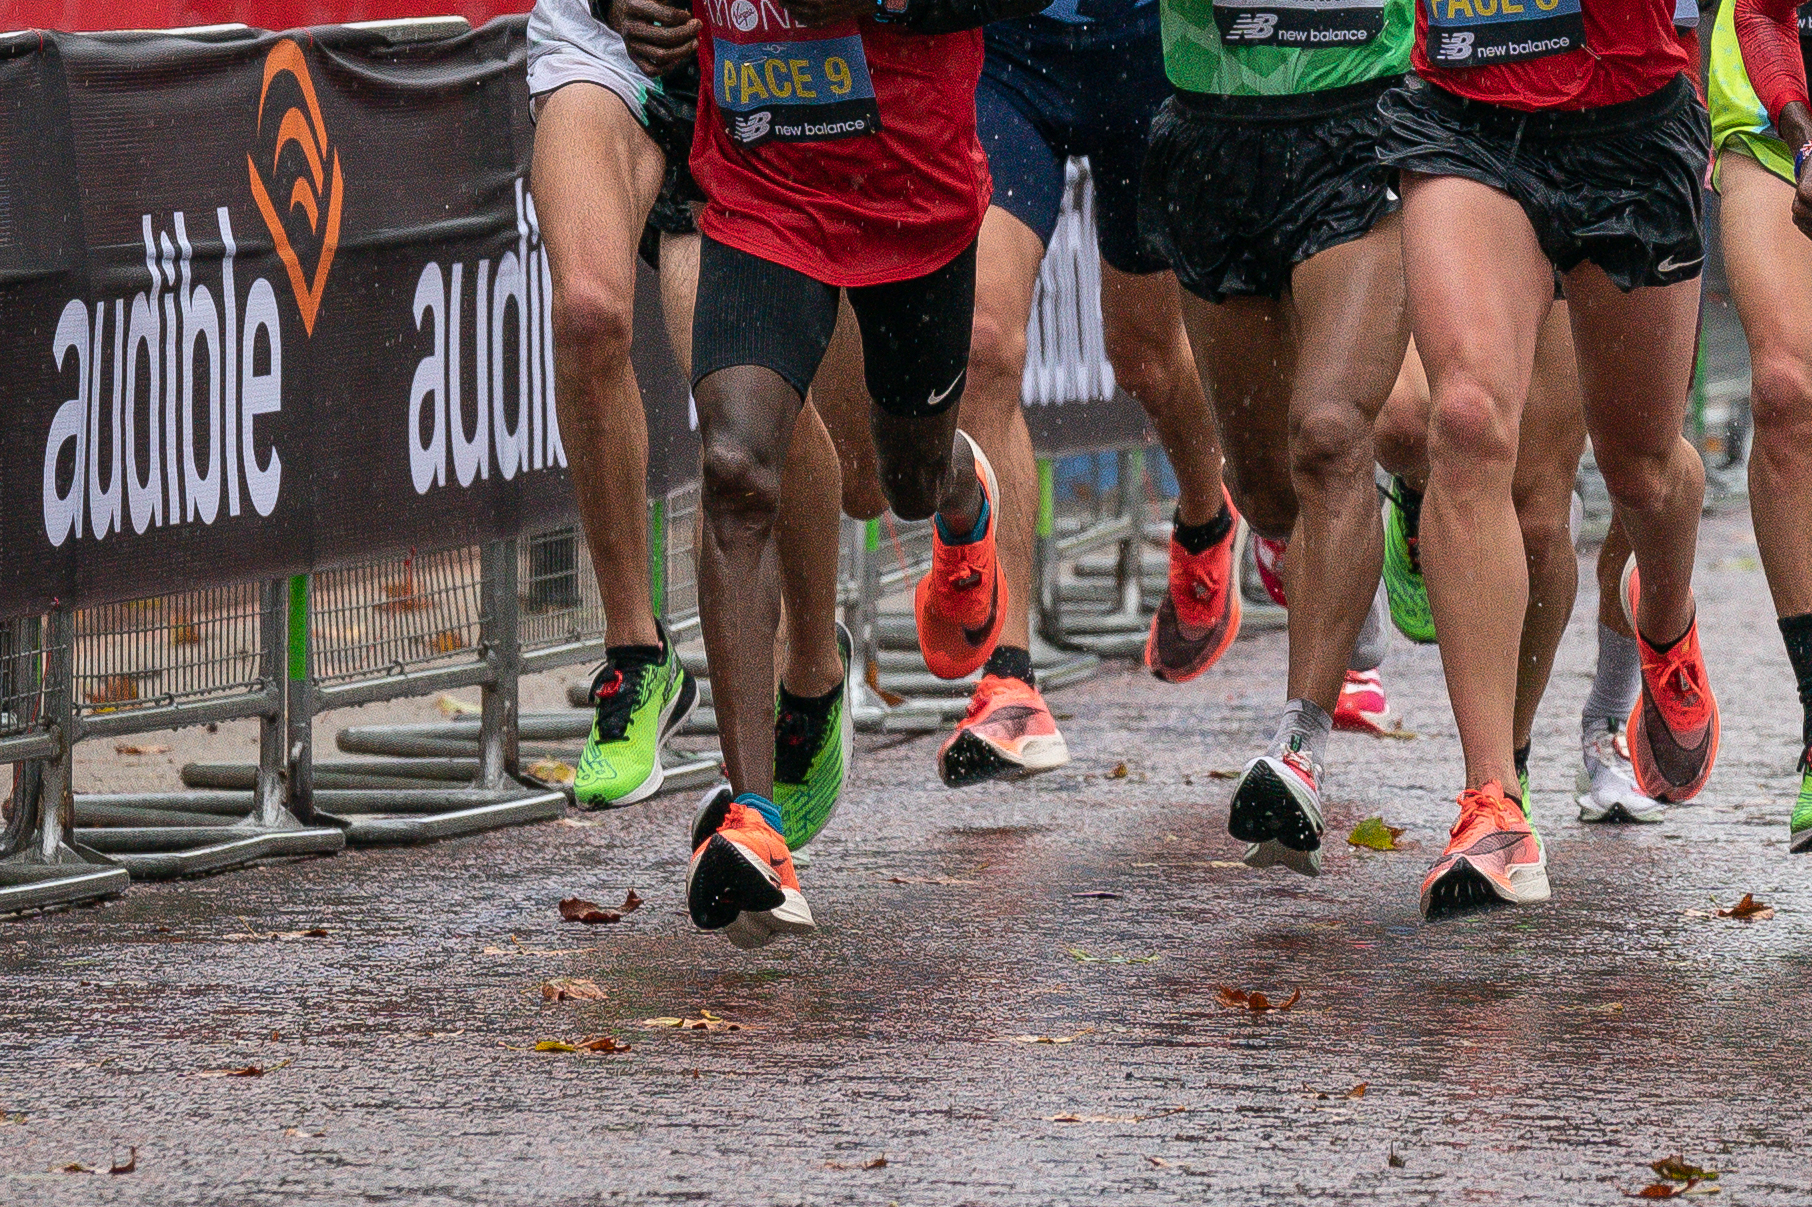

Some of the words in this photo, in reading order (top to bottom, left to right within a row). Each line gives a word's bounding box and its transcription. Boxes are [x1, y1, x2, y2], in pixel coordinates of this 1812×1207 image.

[1278, 29, 1307, 41] new
[1310, 28, 1368, 42] balance
[1477, 44, 1507, 58] new
[1509, 36, 1570, 56] balance
[723, 57, 817, 105] PACE
[824, 56, 852, 94] 9
[774, 124, 802, 136] new
[804, 119, 865, 136] balance
[408, 178, 568, 495] audi
[43, 206, 282, 547] audible
